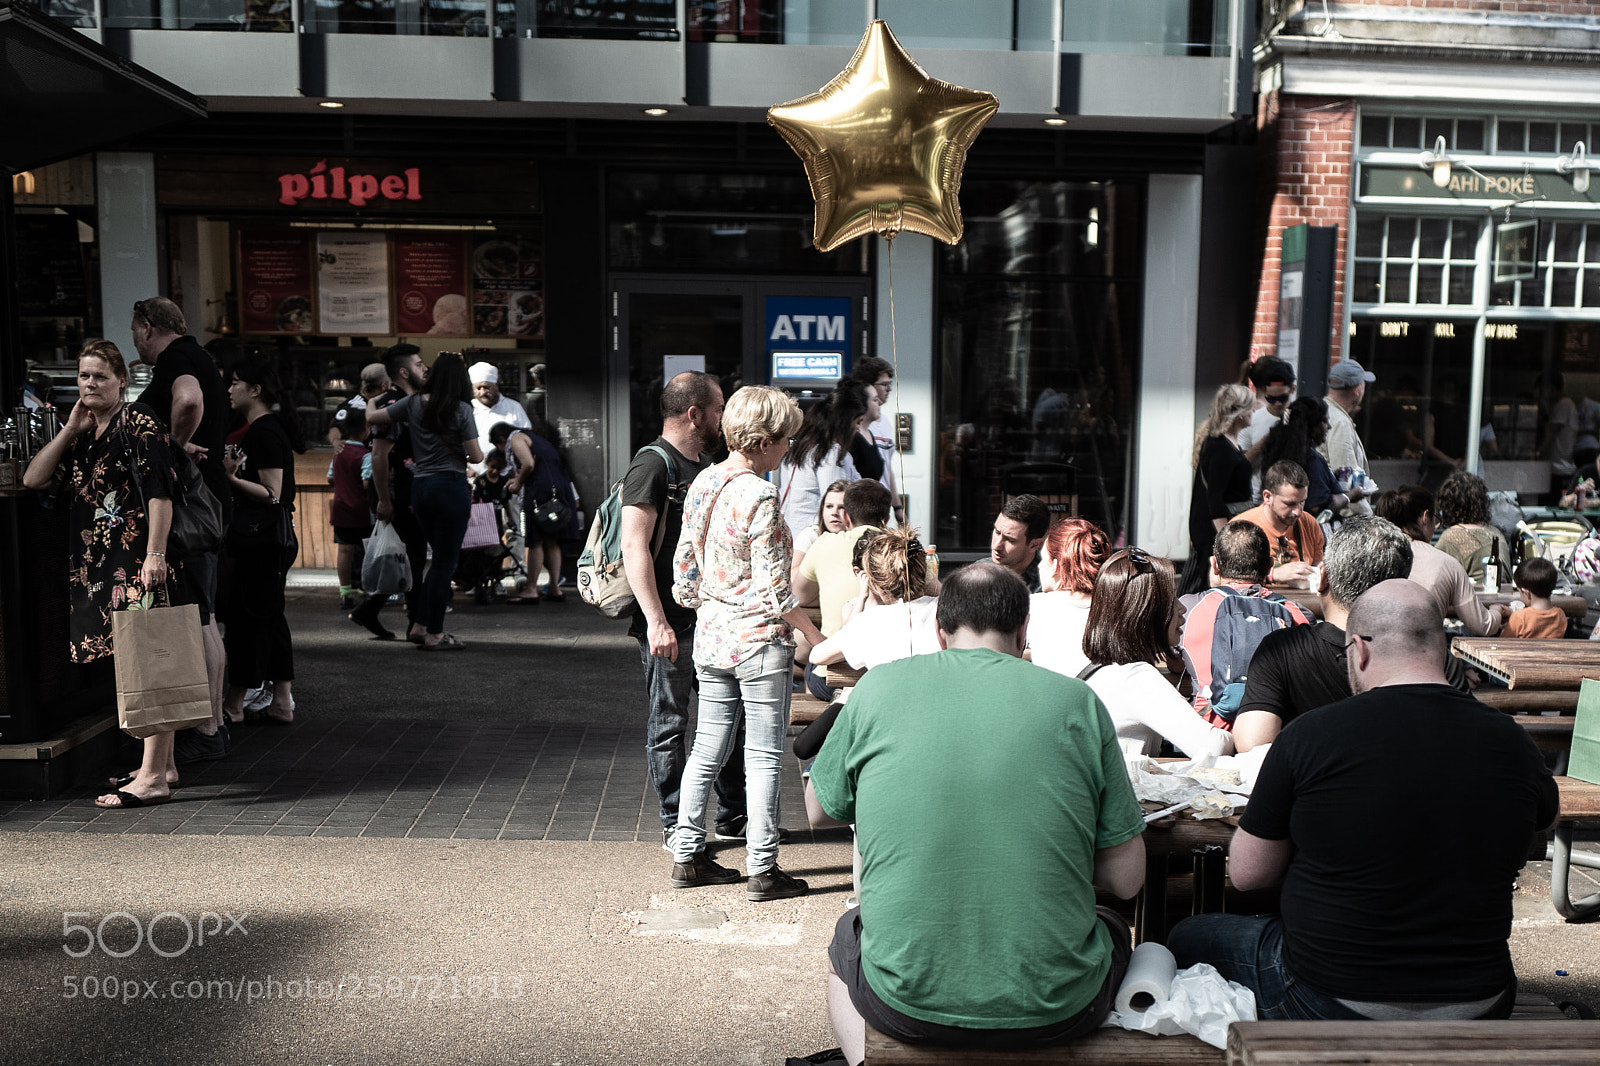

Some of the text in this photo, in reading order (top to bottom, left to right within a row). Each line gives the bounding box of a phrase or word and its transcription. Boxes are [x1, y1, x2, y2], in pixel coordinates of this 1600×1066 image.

[1448, 174, 1480, 193] AHI
[770, 314, 845, 341] ATM
[1380, 321, 1410, 337] DON'T
[1434, 321, 1456, 338] KILL
[778, 357, 837, 367] FREE CASH
